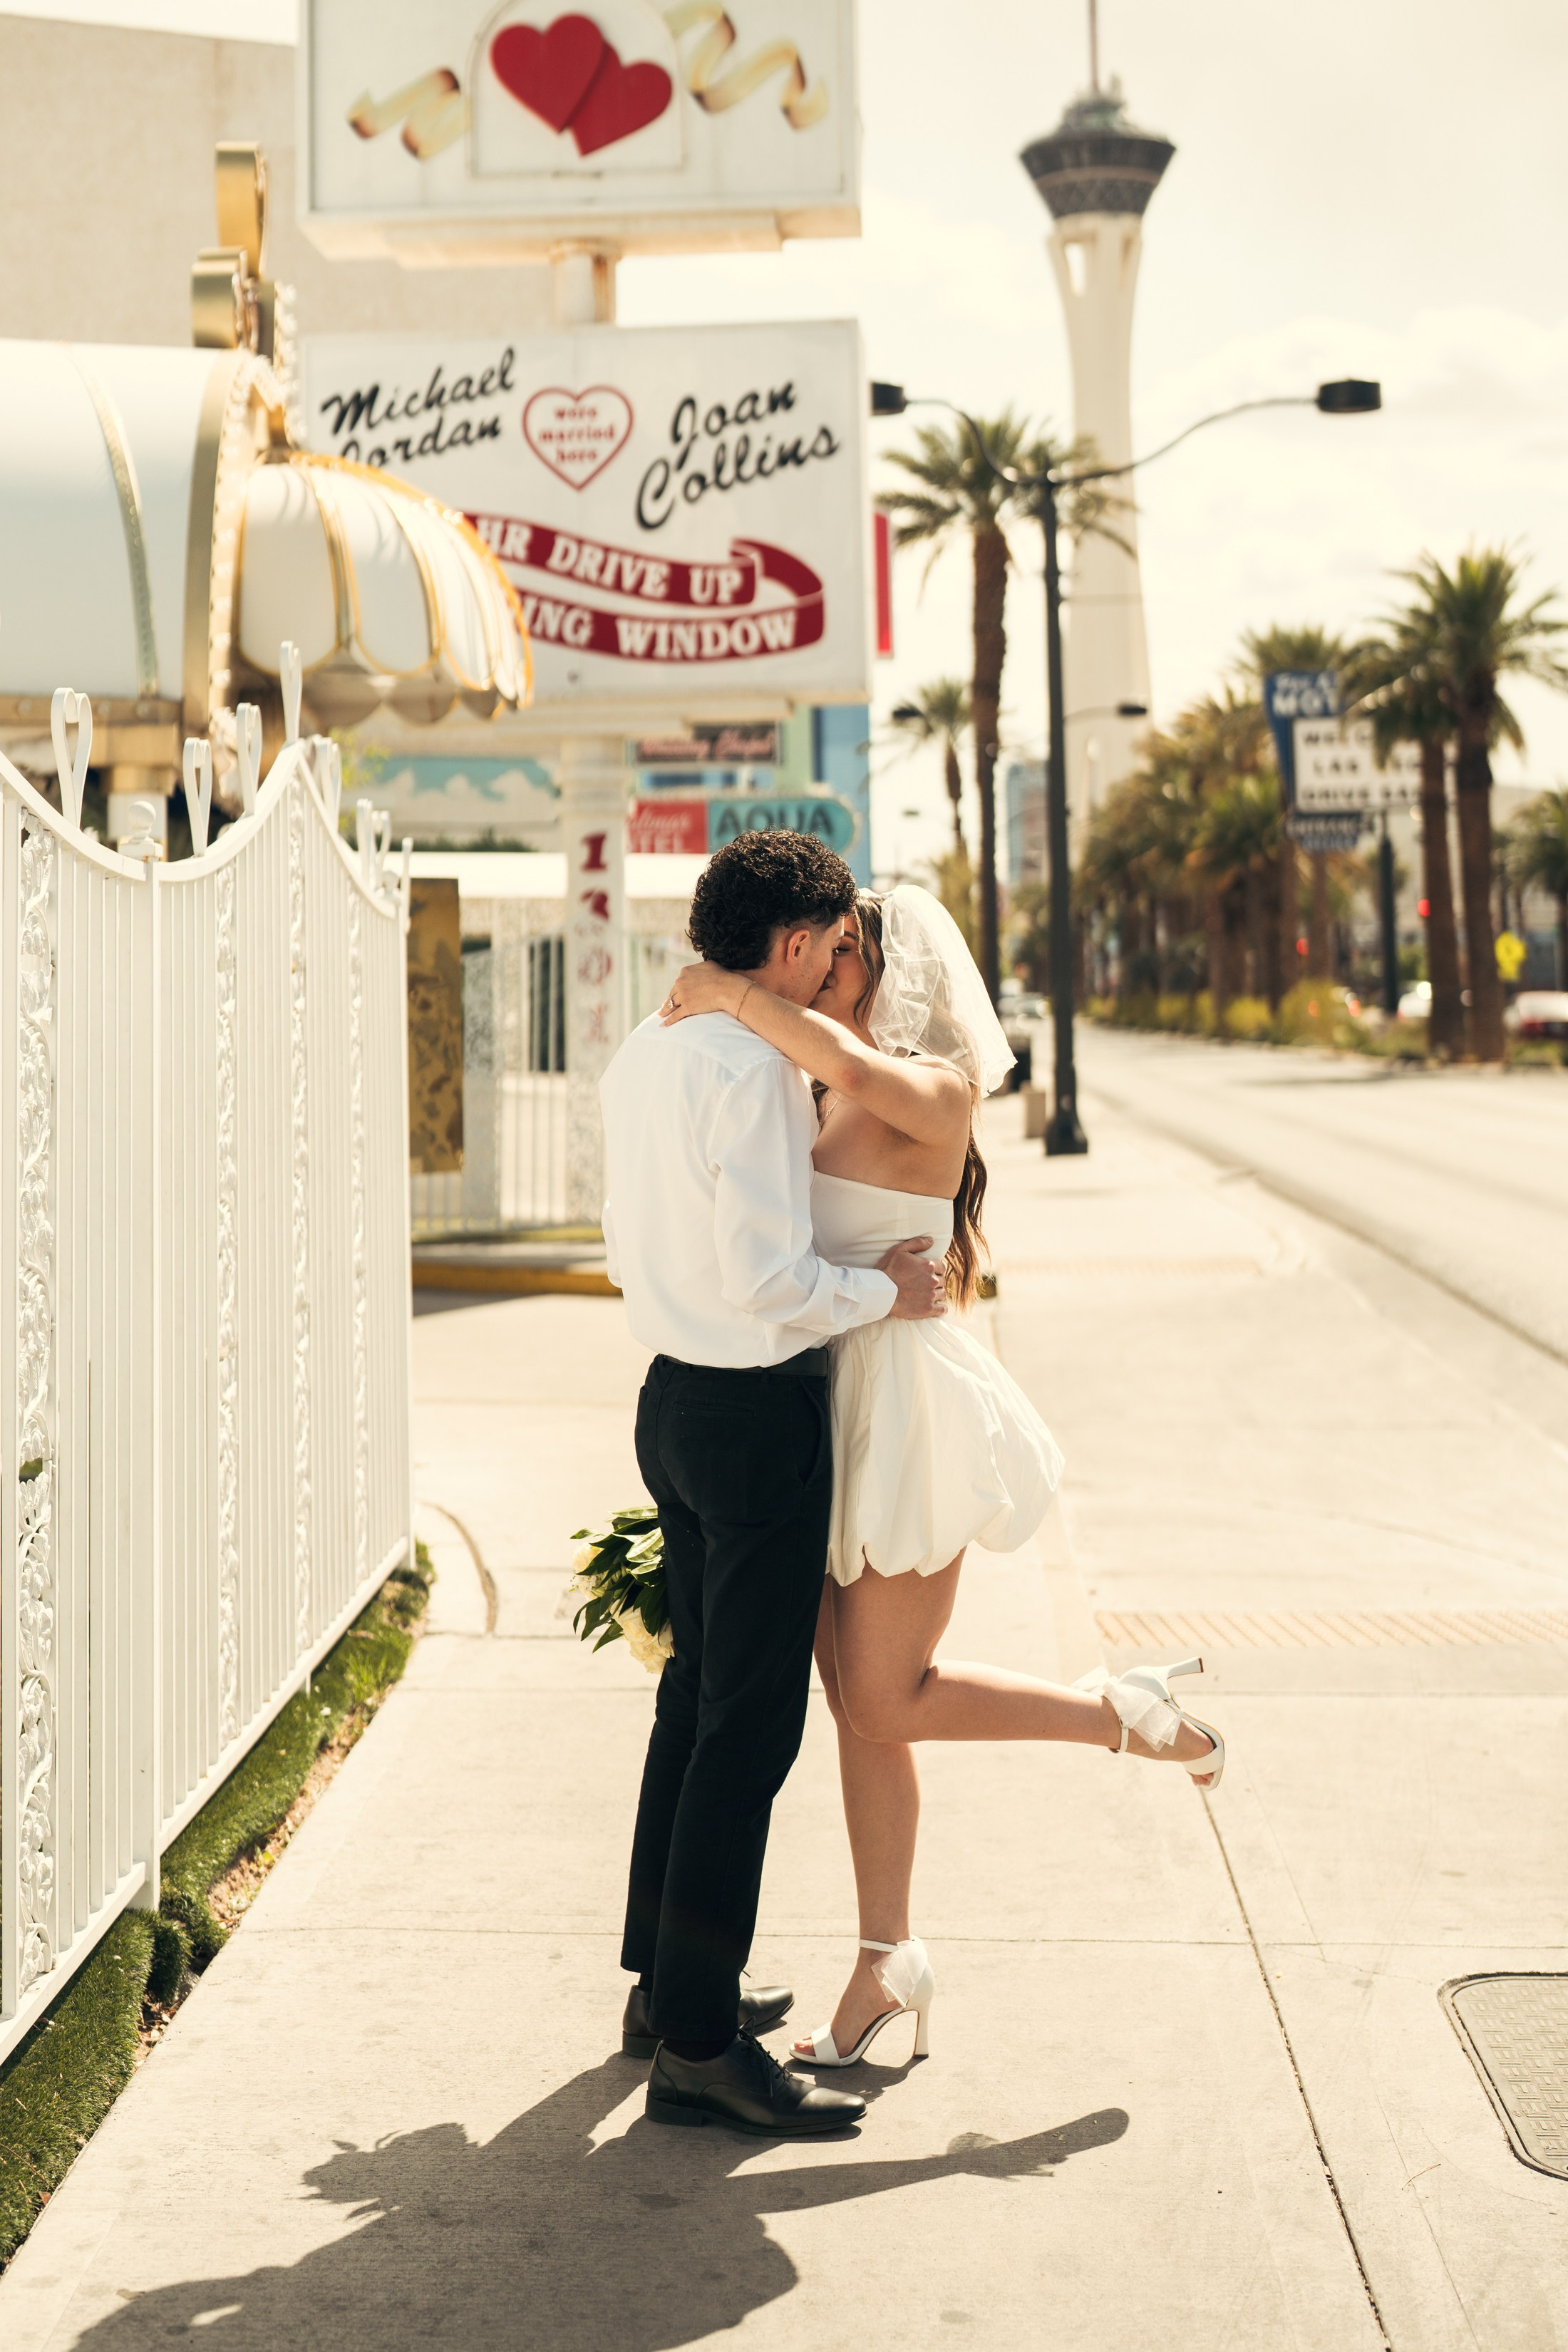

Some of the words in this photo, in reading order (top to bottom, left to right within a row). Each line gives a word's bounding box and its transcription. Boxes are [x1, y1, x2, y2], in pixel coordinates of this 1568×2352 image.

[320, 345, 515, 436] Michael
[554, 406, 597, 421] were
[538, 425, 614, 441] married
[556, 447, 597, 463] here
[671, 381, 797, 473] Joan
[635, 423, 840, 531] Collins
[546, 534, 669, 598] DRIVE
[689, 568, 743, 604] UP
[616, 609, 798, 659] WINDOW
